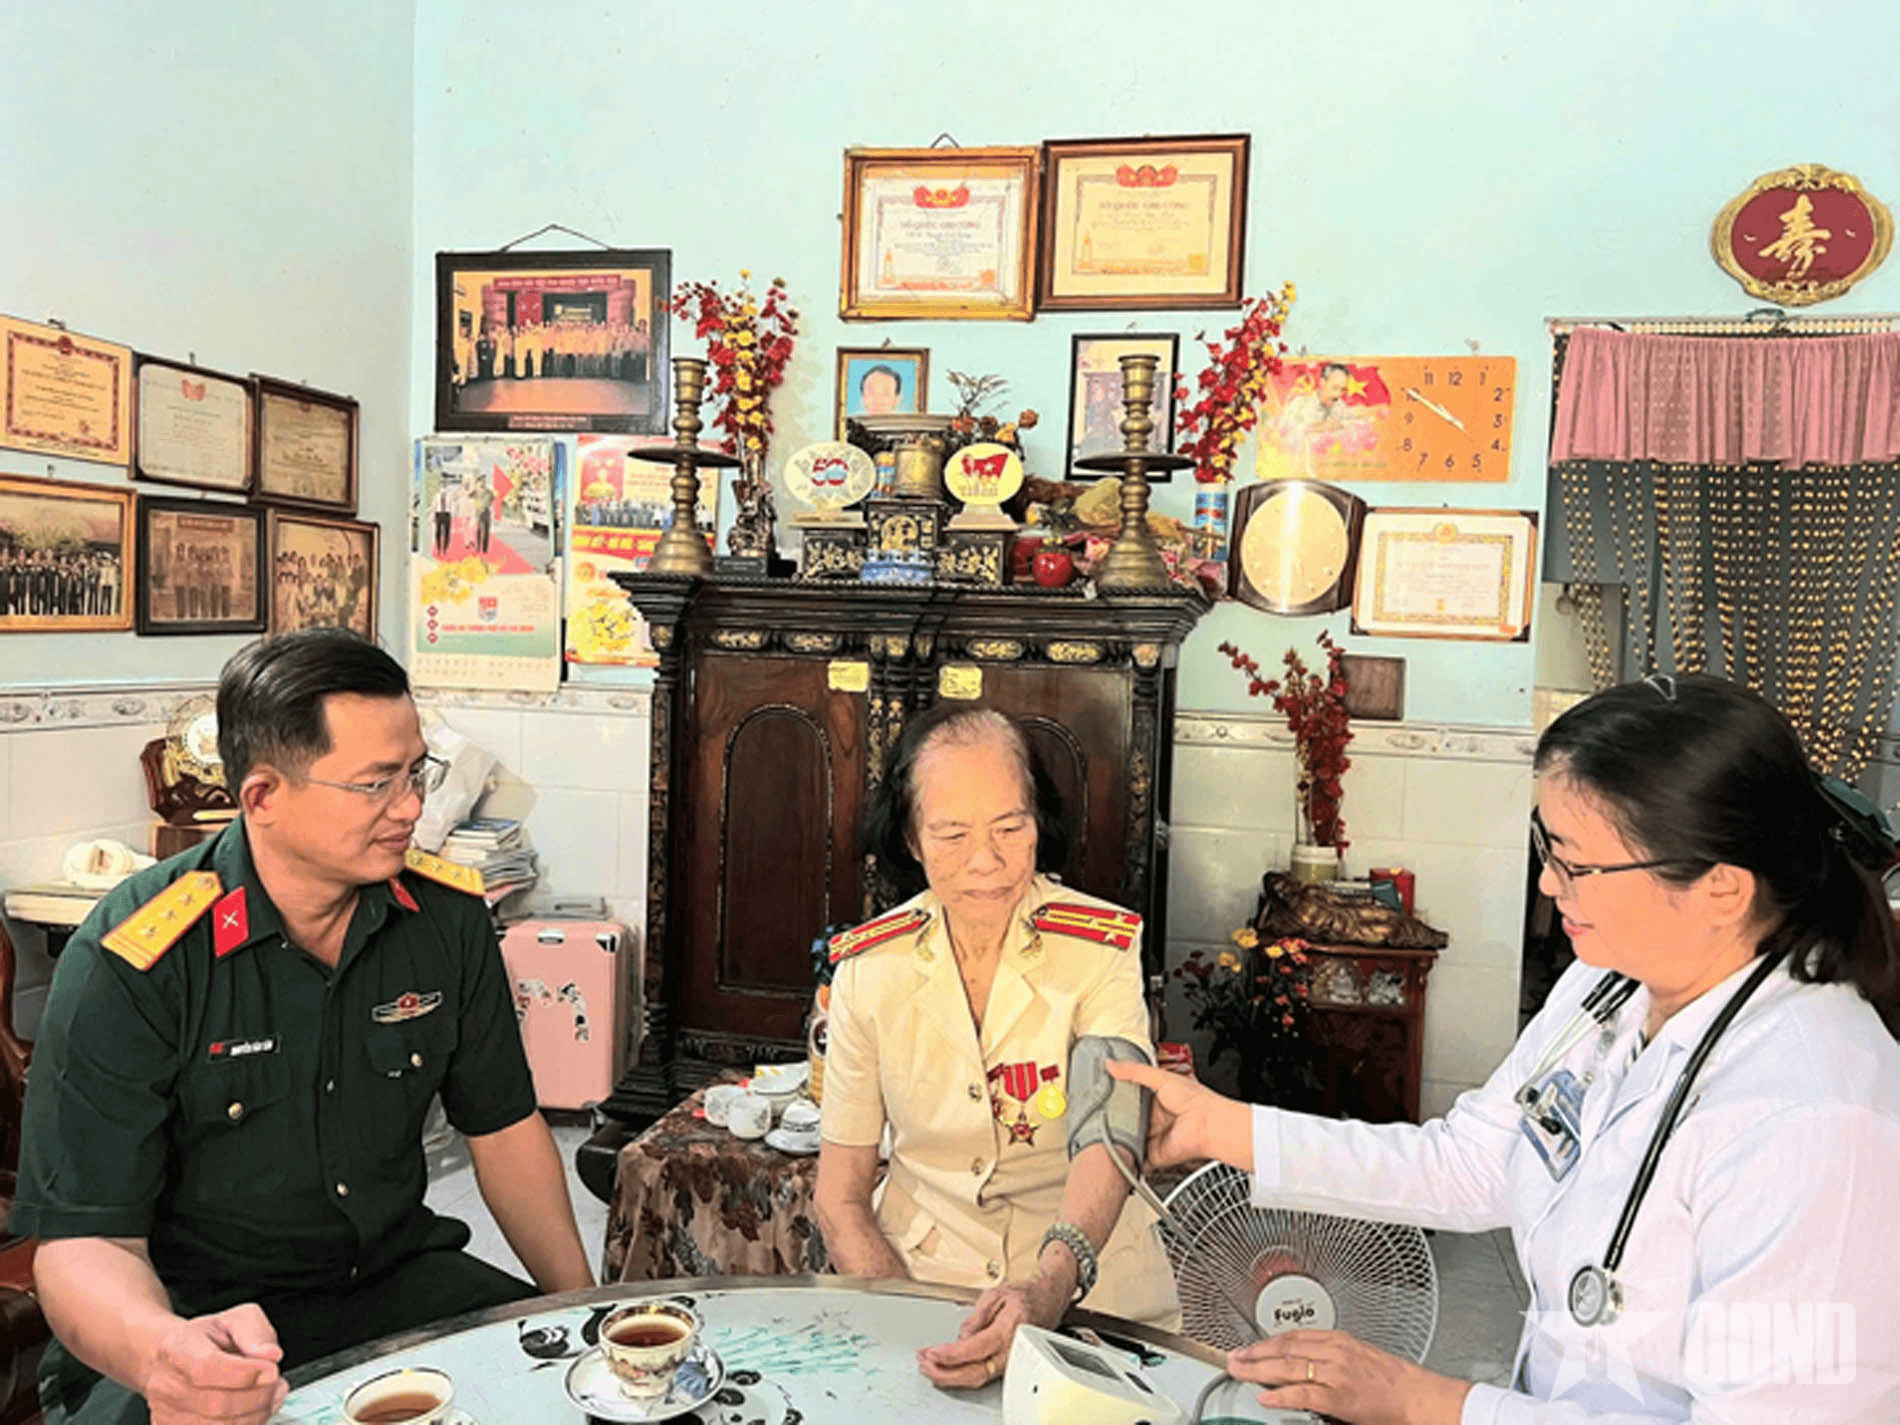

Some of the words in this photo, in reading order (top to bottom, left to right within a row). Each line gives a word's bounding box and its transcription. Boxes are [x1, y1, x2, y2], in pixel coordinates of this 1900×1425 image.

[1424, 371, 1434, 386] 11
[1448, 370, 1463, 387] 12
[1479, 371, 1486, 386] 1
[1494, 386, 1504, 402] 2
[1492, 412, 1503, 429] 3
[1402, 436, 1413, 452] 8
[1490, 438, 1500, 451] 4
[1419, 451, 1429, 467] 7
[1444, 453, 1455, 468] 6
[1471, 452, 1481, 469] 5
